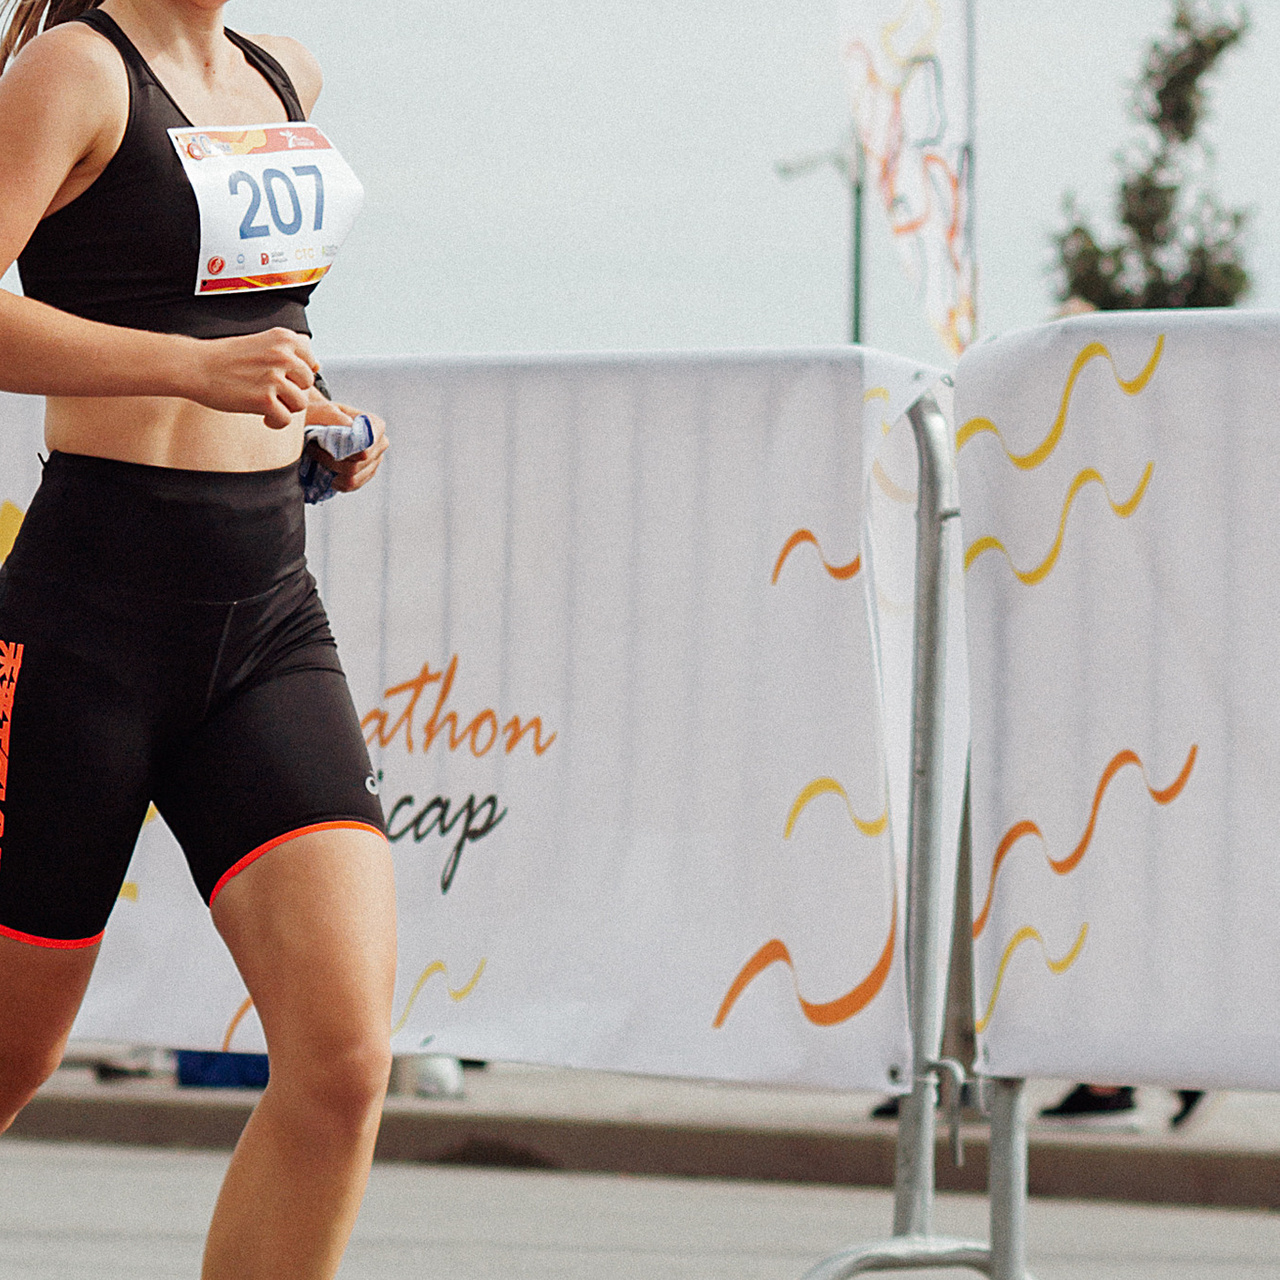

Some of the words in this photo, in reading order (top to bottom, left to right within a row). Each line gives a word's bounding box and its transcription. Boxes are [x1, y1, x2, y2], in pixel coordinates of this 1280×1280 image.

[228, 165, 324, 240] 207
[360, 653, 558, 757] athon
[378, 770, 508, 895] cap
